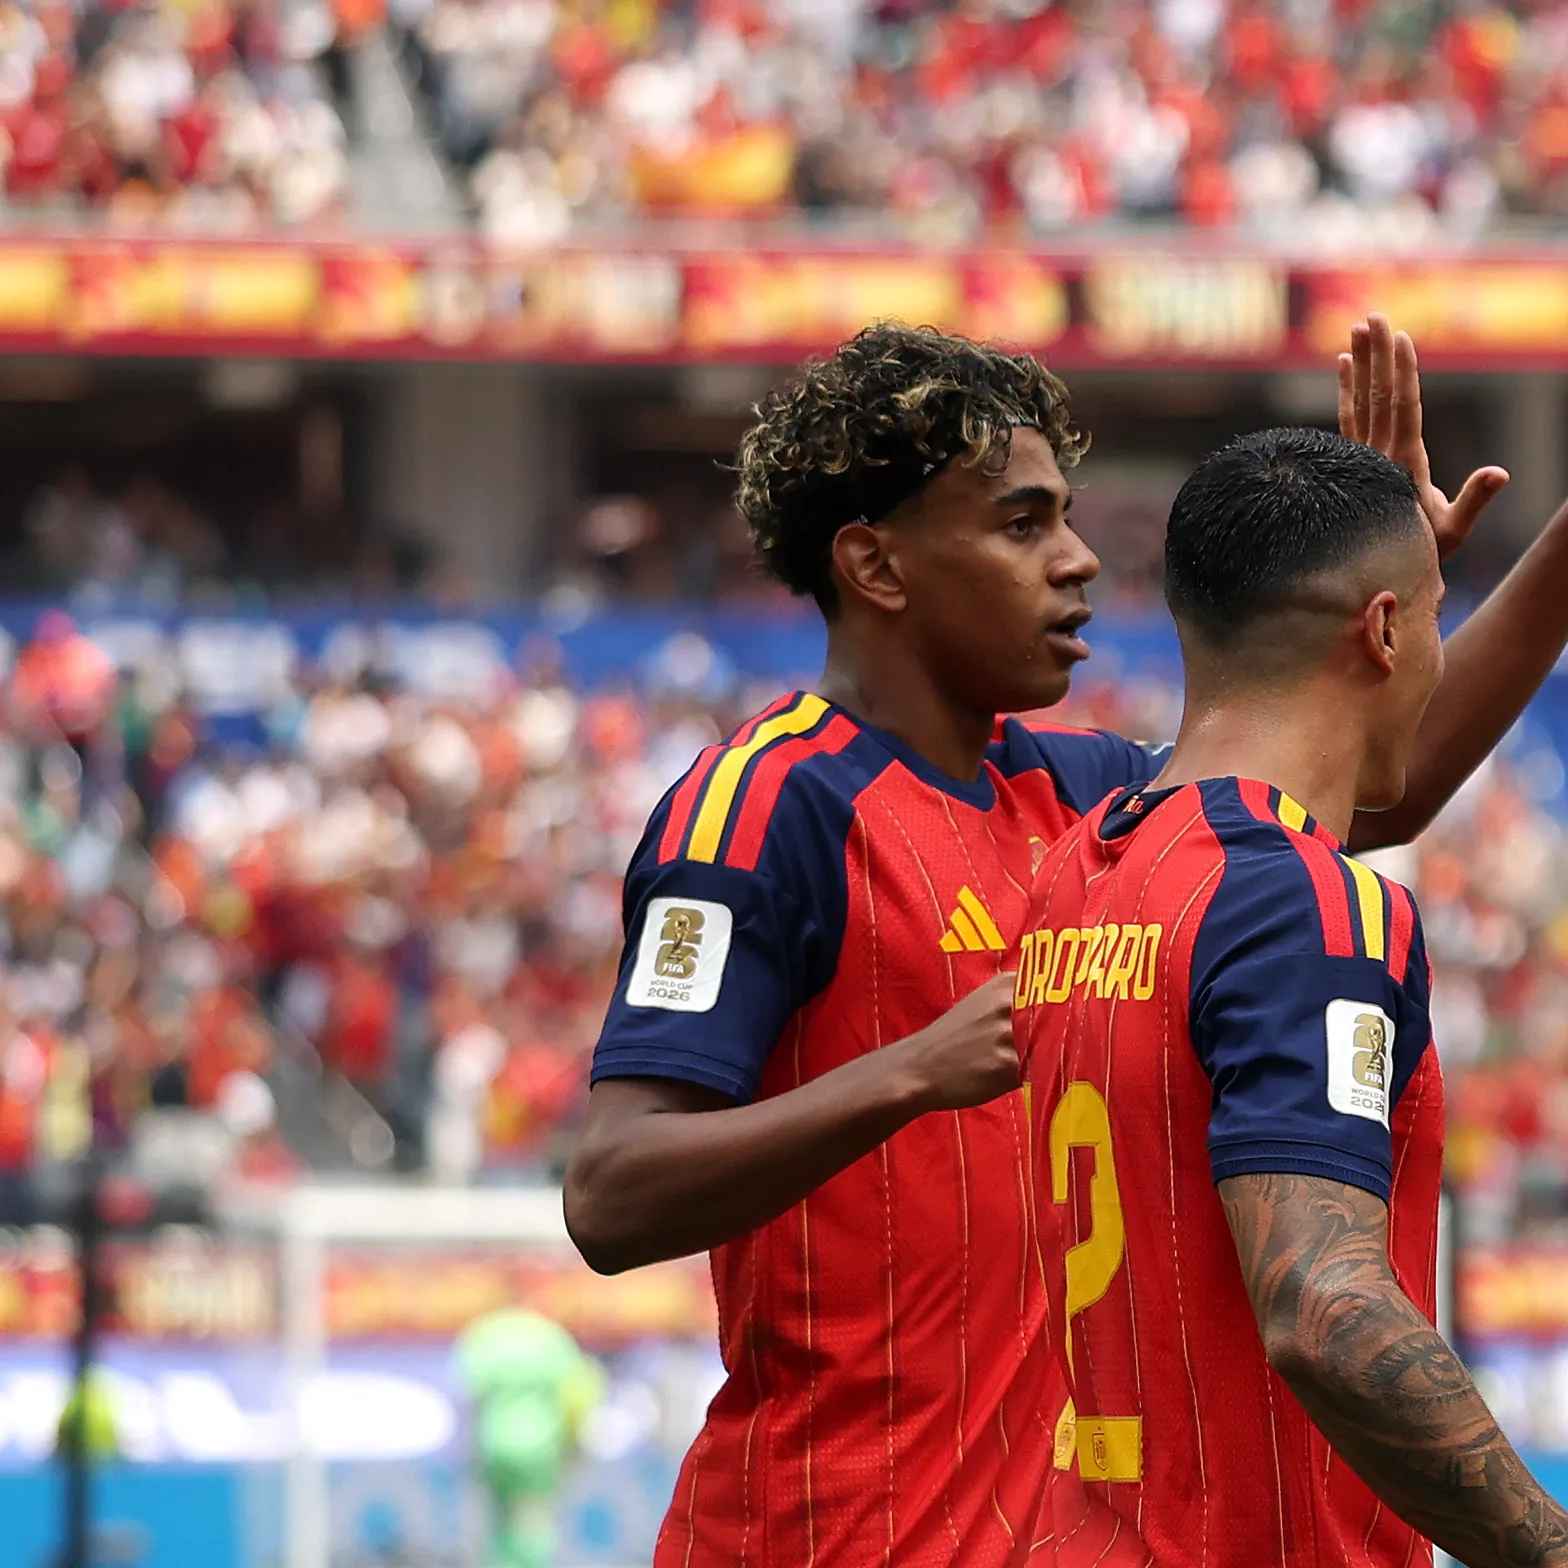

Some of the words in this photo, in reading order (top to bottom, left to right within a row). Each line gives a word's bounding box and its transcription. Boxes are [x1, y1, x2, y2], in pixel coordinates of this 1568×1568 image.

[663, 962, 685, 975] FIFA
[650, 979, 677, 989] WORLD
[677, 981, 694, 991] CUP
[647, 987, 691, 1002] 2026
[1364, 1071, 1384, 1083] FIFA
[1351, 1087, 1380, 1099] WORLD
[1350, 1096, 1386, 1116] 202
